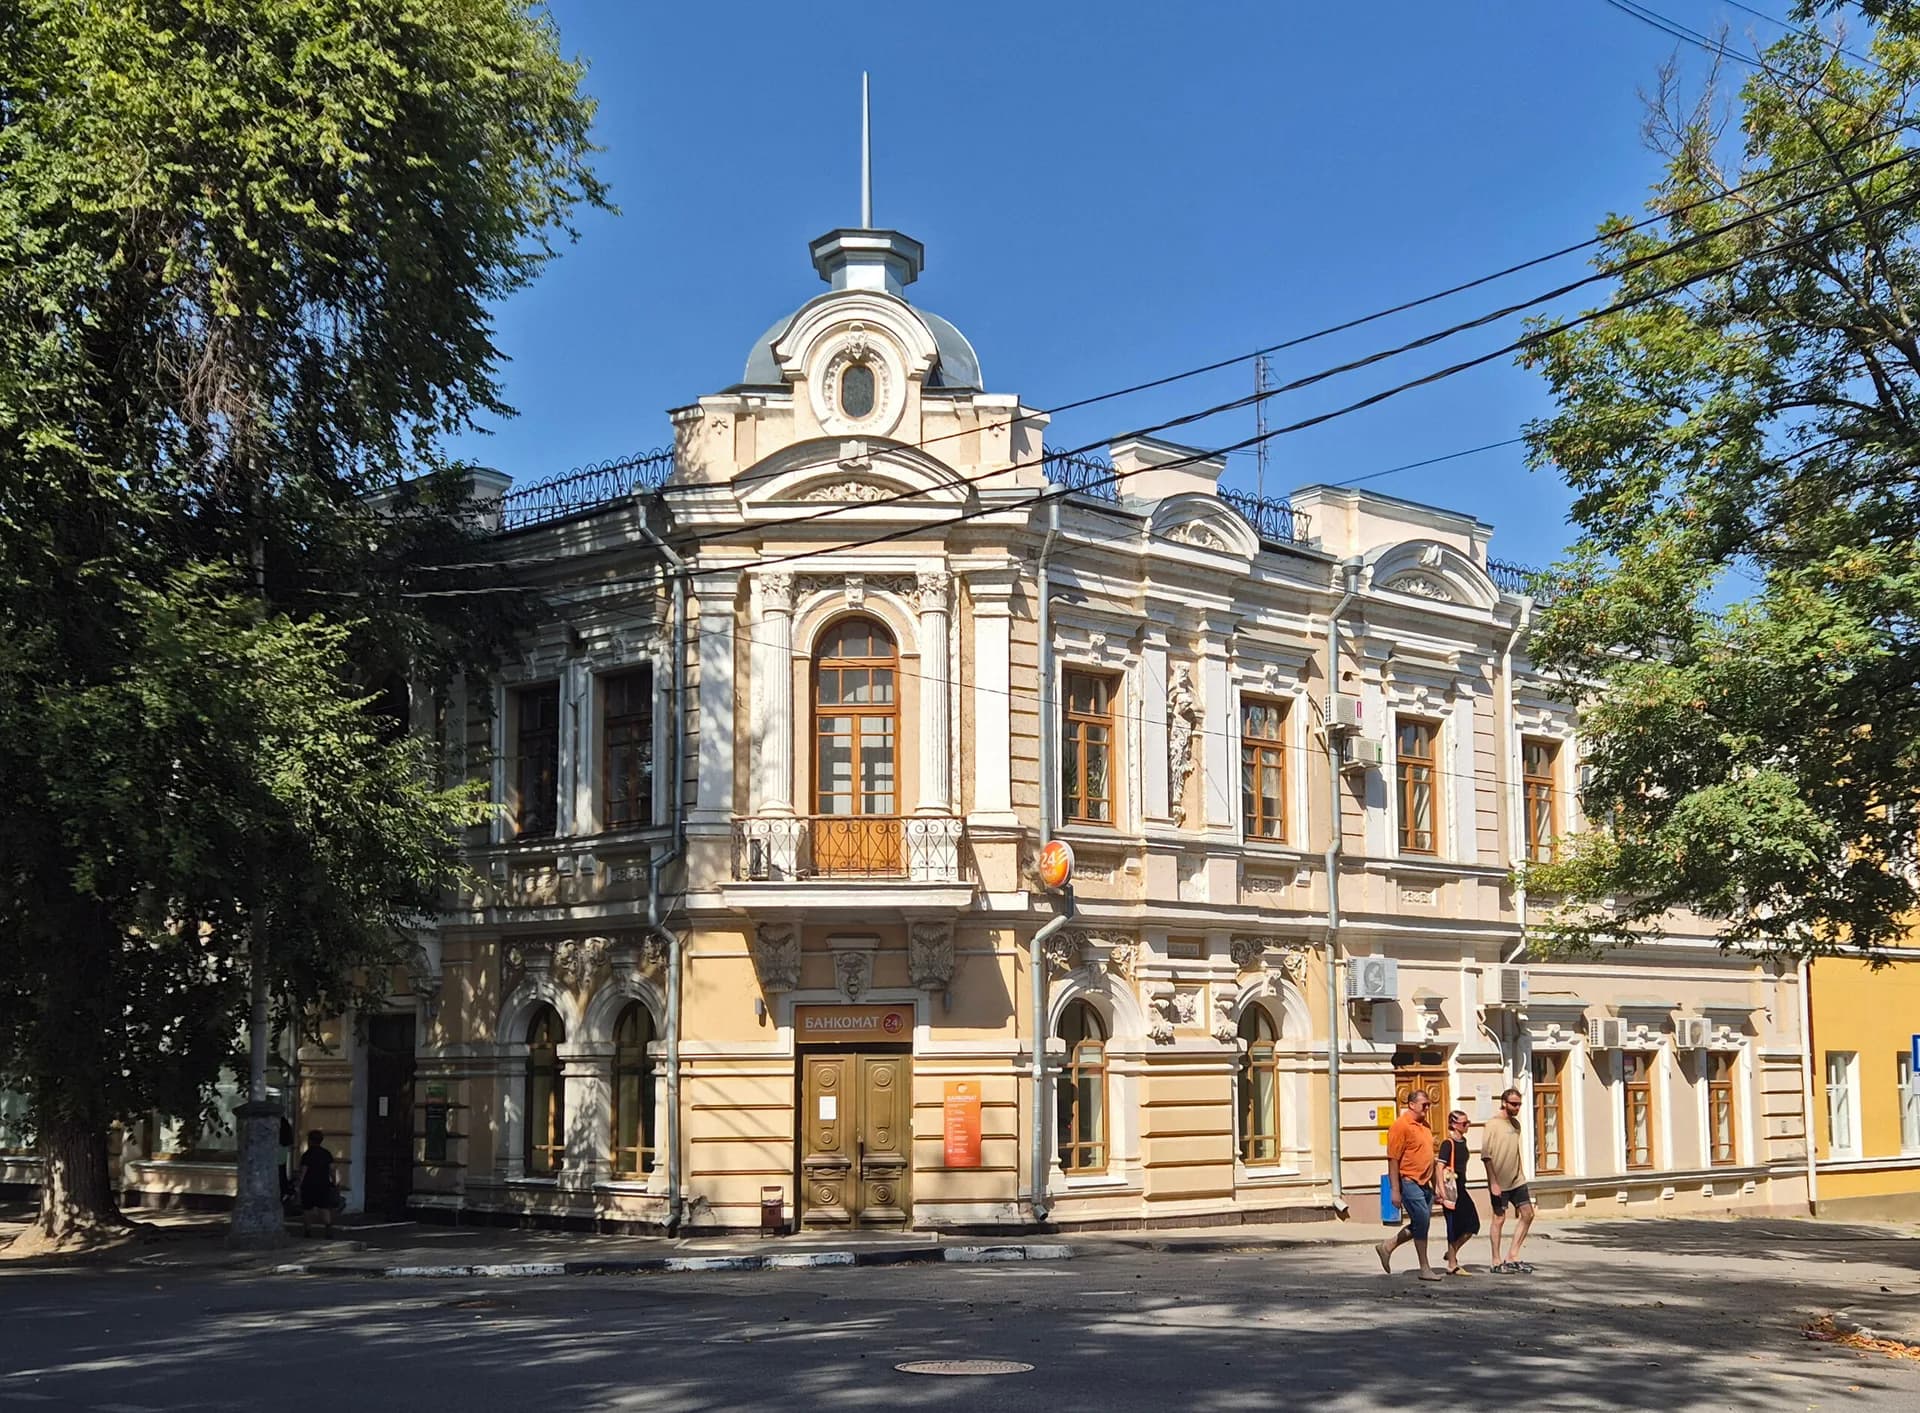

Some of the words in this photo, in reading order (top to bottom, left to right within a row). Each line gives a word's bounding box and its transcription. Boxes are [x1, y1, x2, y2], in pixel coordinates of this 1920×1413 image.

[1040, 852, 1057, 868] 24
[805, 1016, 880, 1029] БАНКОМАТ
[885, 1017, 898, 1029] 24
